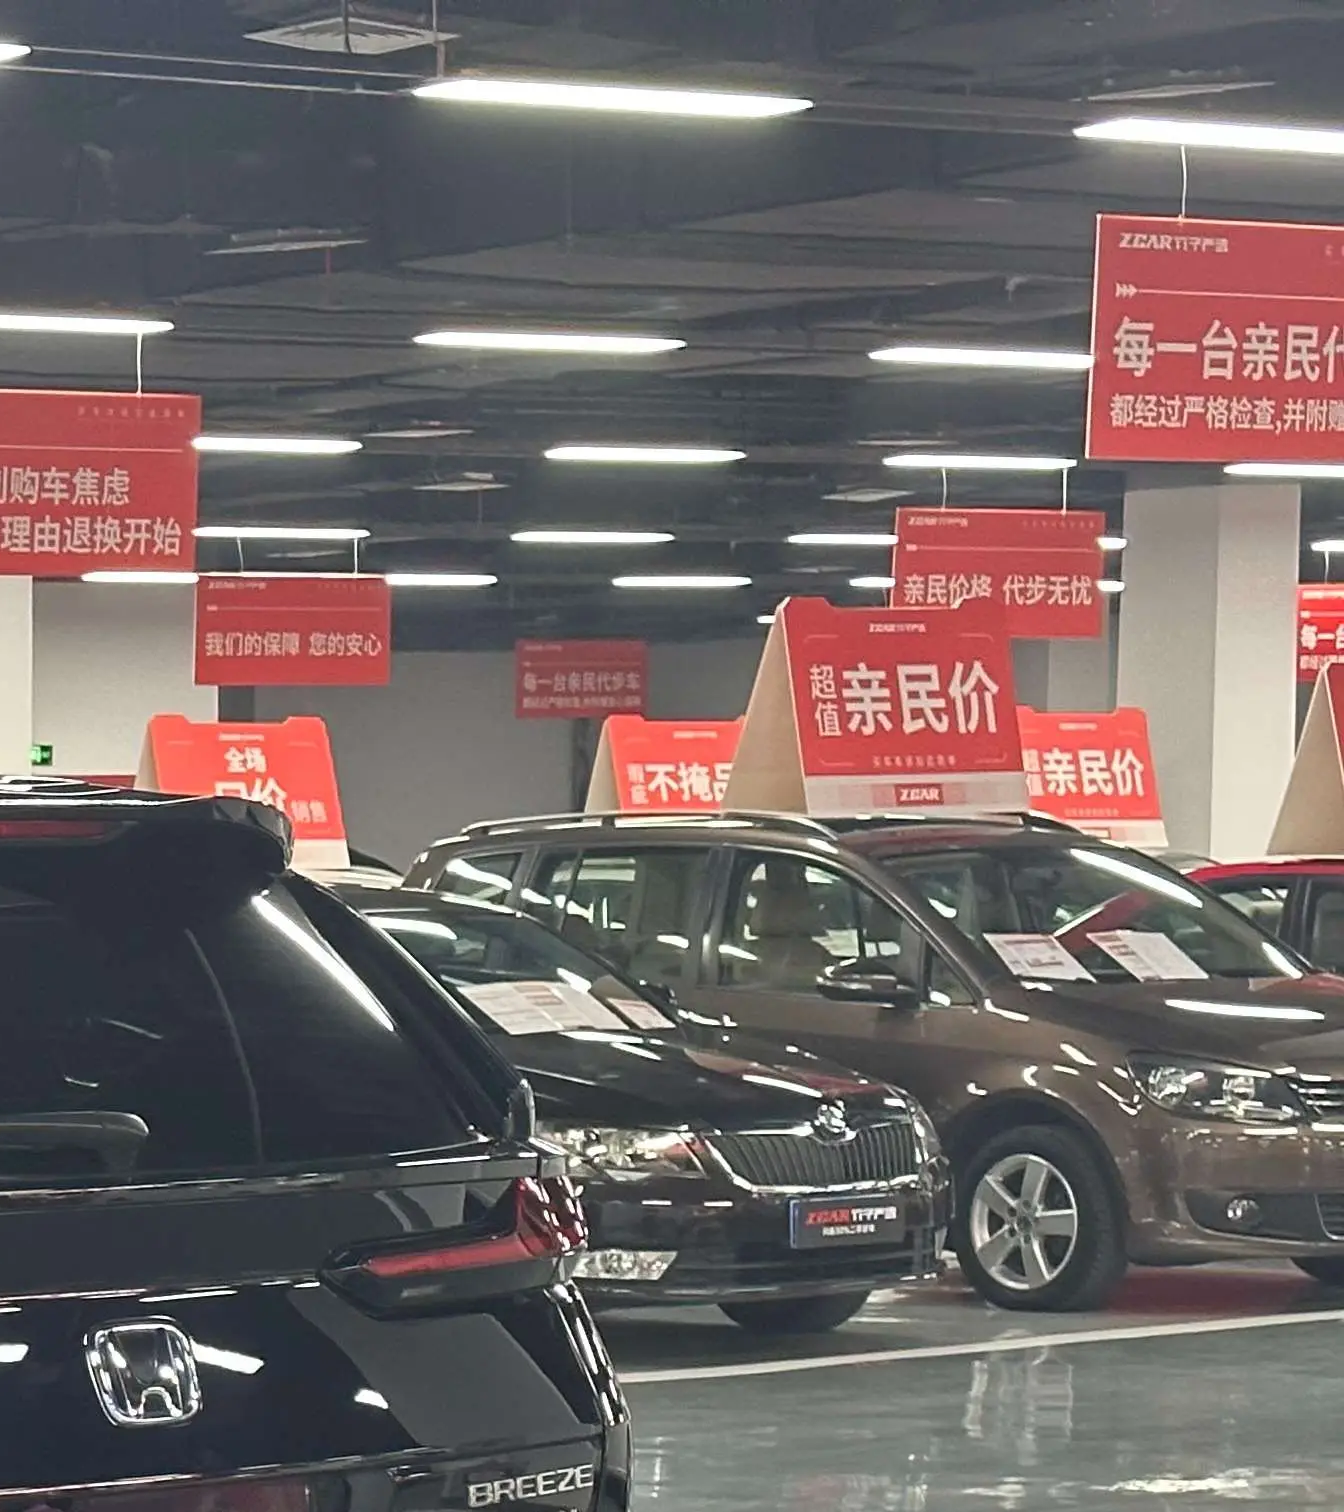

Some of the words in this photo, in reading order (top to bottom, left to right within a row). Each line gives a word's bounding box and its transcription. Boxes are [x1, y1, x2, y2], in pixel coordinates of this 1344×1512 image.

[904, 573, 993, 605] 亲民价格
[1002, 574, 1092, 606] 代步无忧
[205, 631, 300, 657] 我们的保障
[308, 632, 383, 657] 您的安心
[809, 664, 843, 737] 超值
[842, 660, 1000, 736] 亲民价
[224, 746, 267, 773] 全场
[1042, 748, 1145, 797] 亲民价
[468, 1464, 594, 1508] BREEZE
